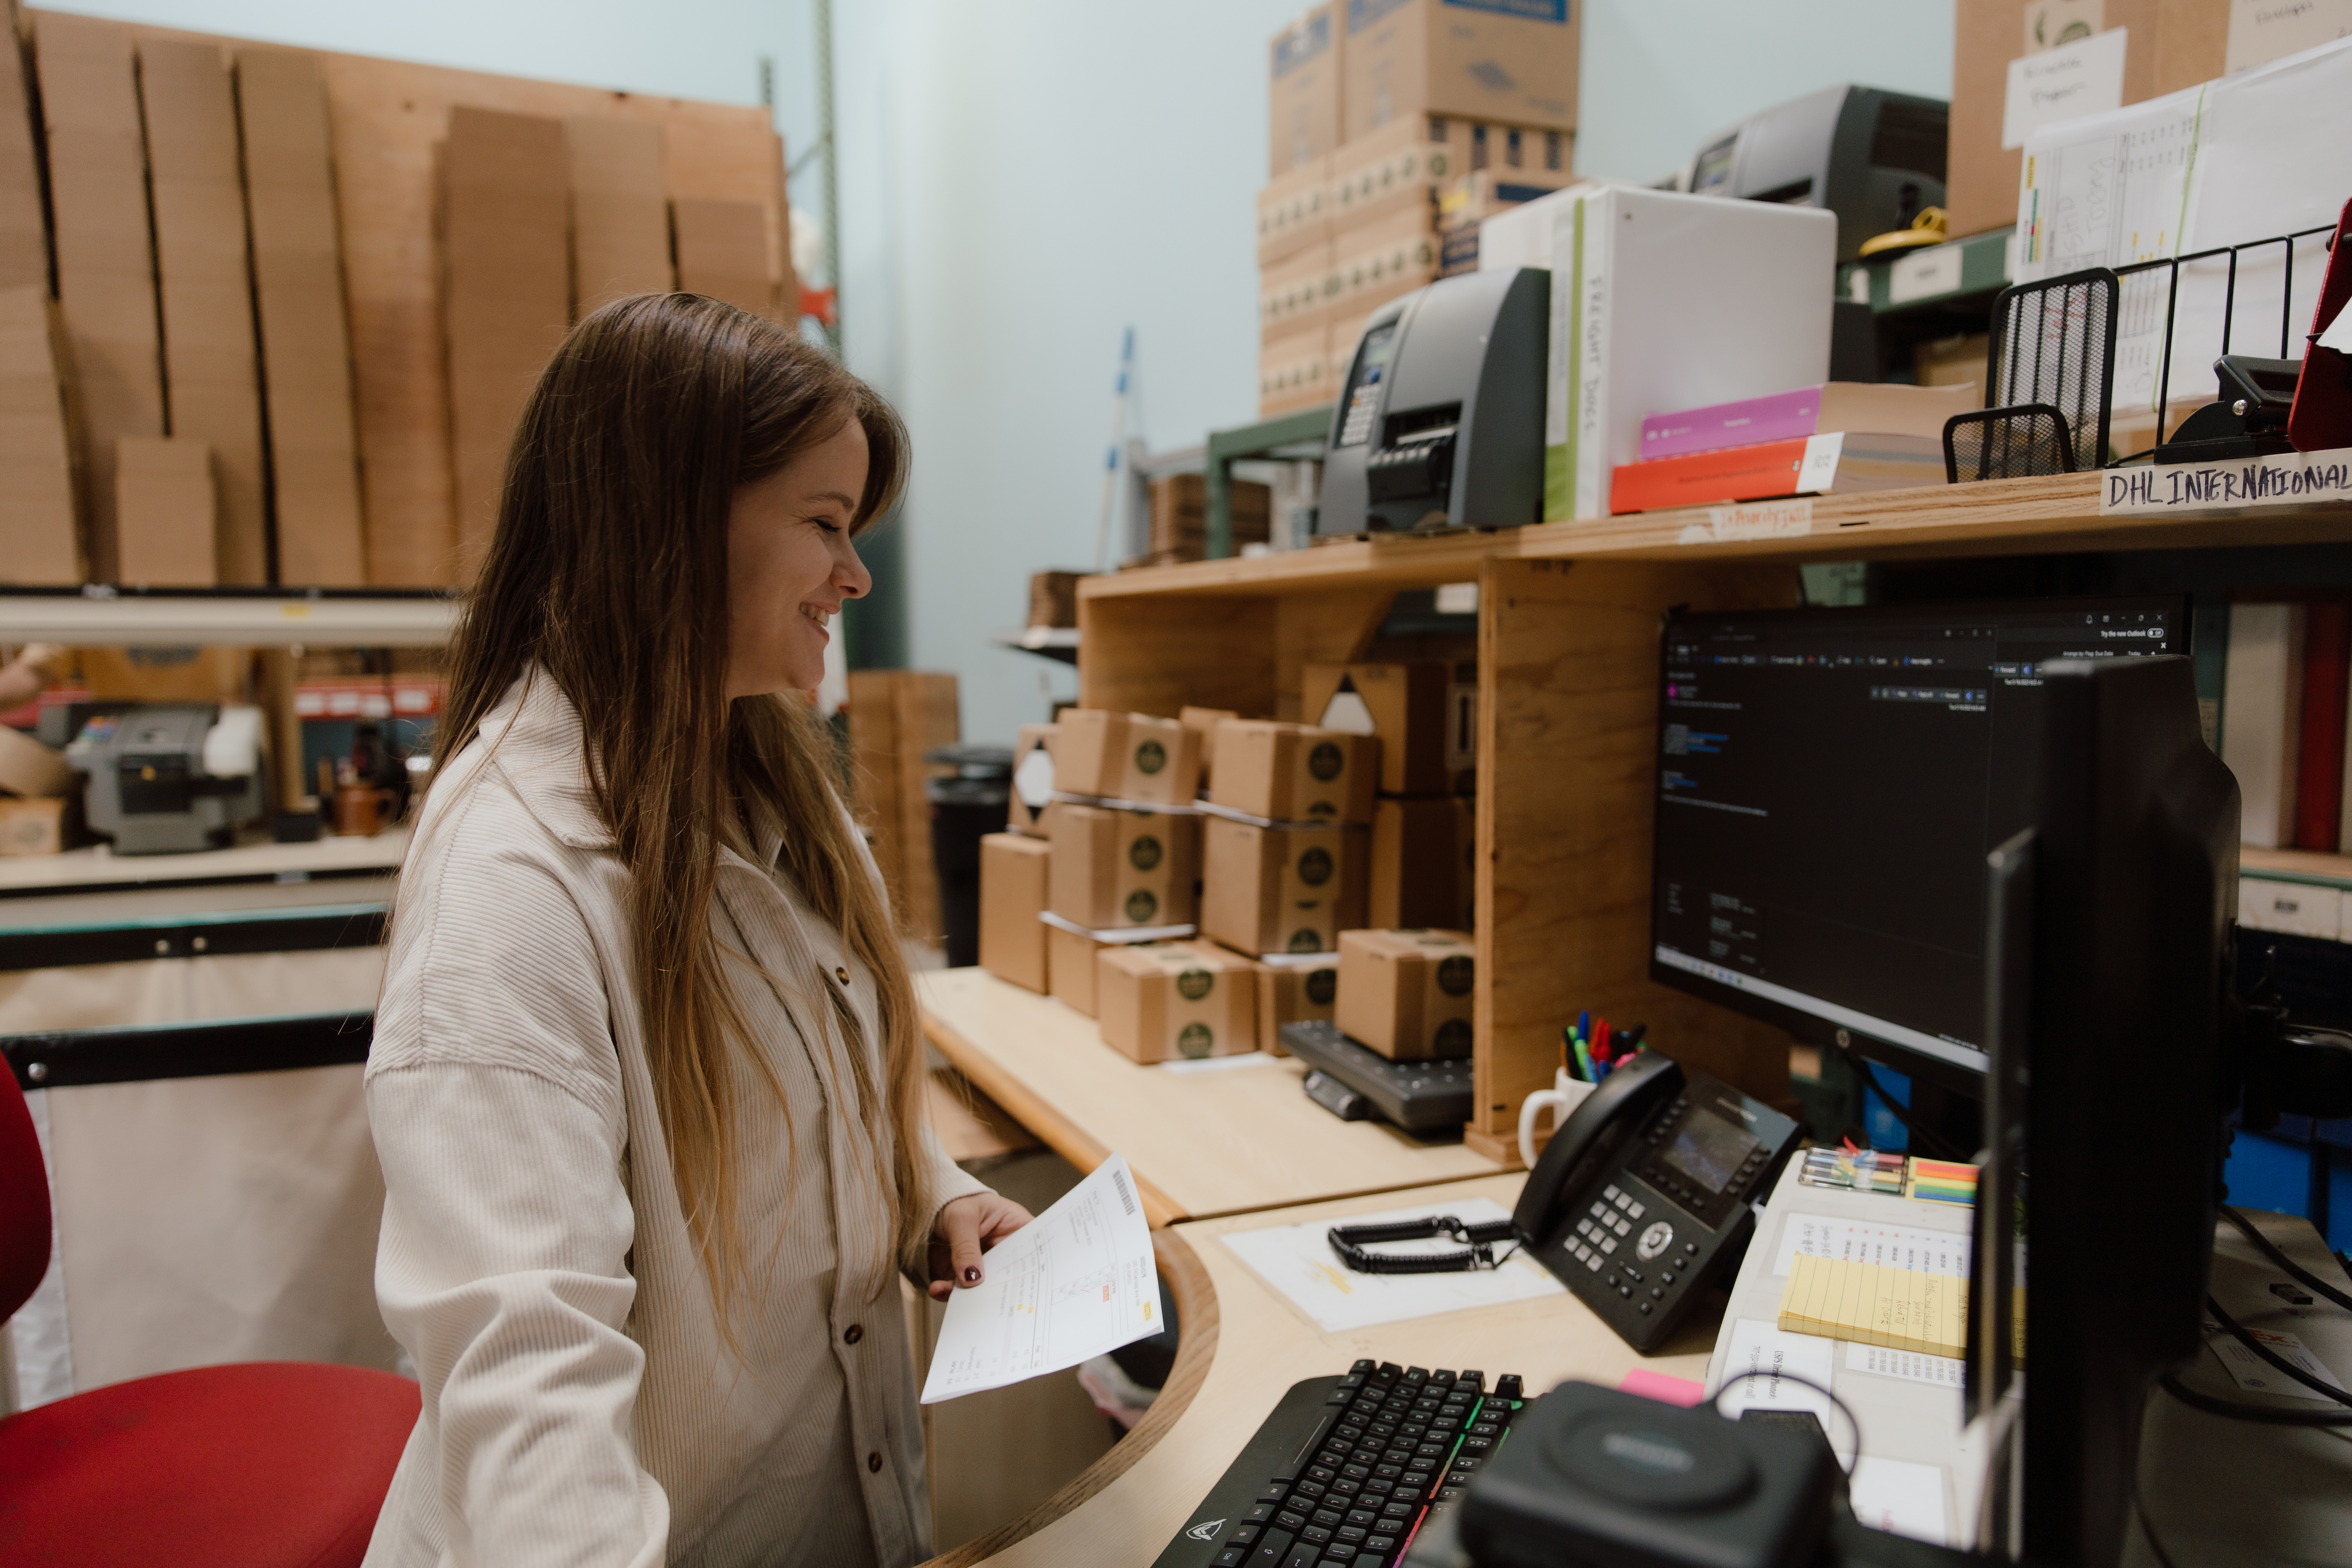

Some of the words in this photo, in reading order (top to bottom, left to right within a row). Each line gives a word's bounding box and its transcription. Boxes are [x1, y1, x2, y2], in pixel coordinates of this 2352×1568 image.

[2109, 470, 2163, 507] DHL
[2166, 464, 2352, 505] INTERNATIONAL
[1773, 1351, 1783, 1363] USPS
[1744, 1389, 1756, 1399] call)
[1769, 1378, 1780, 1399] Phone#:
